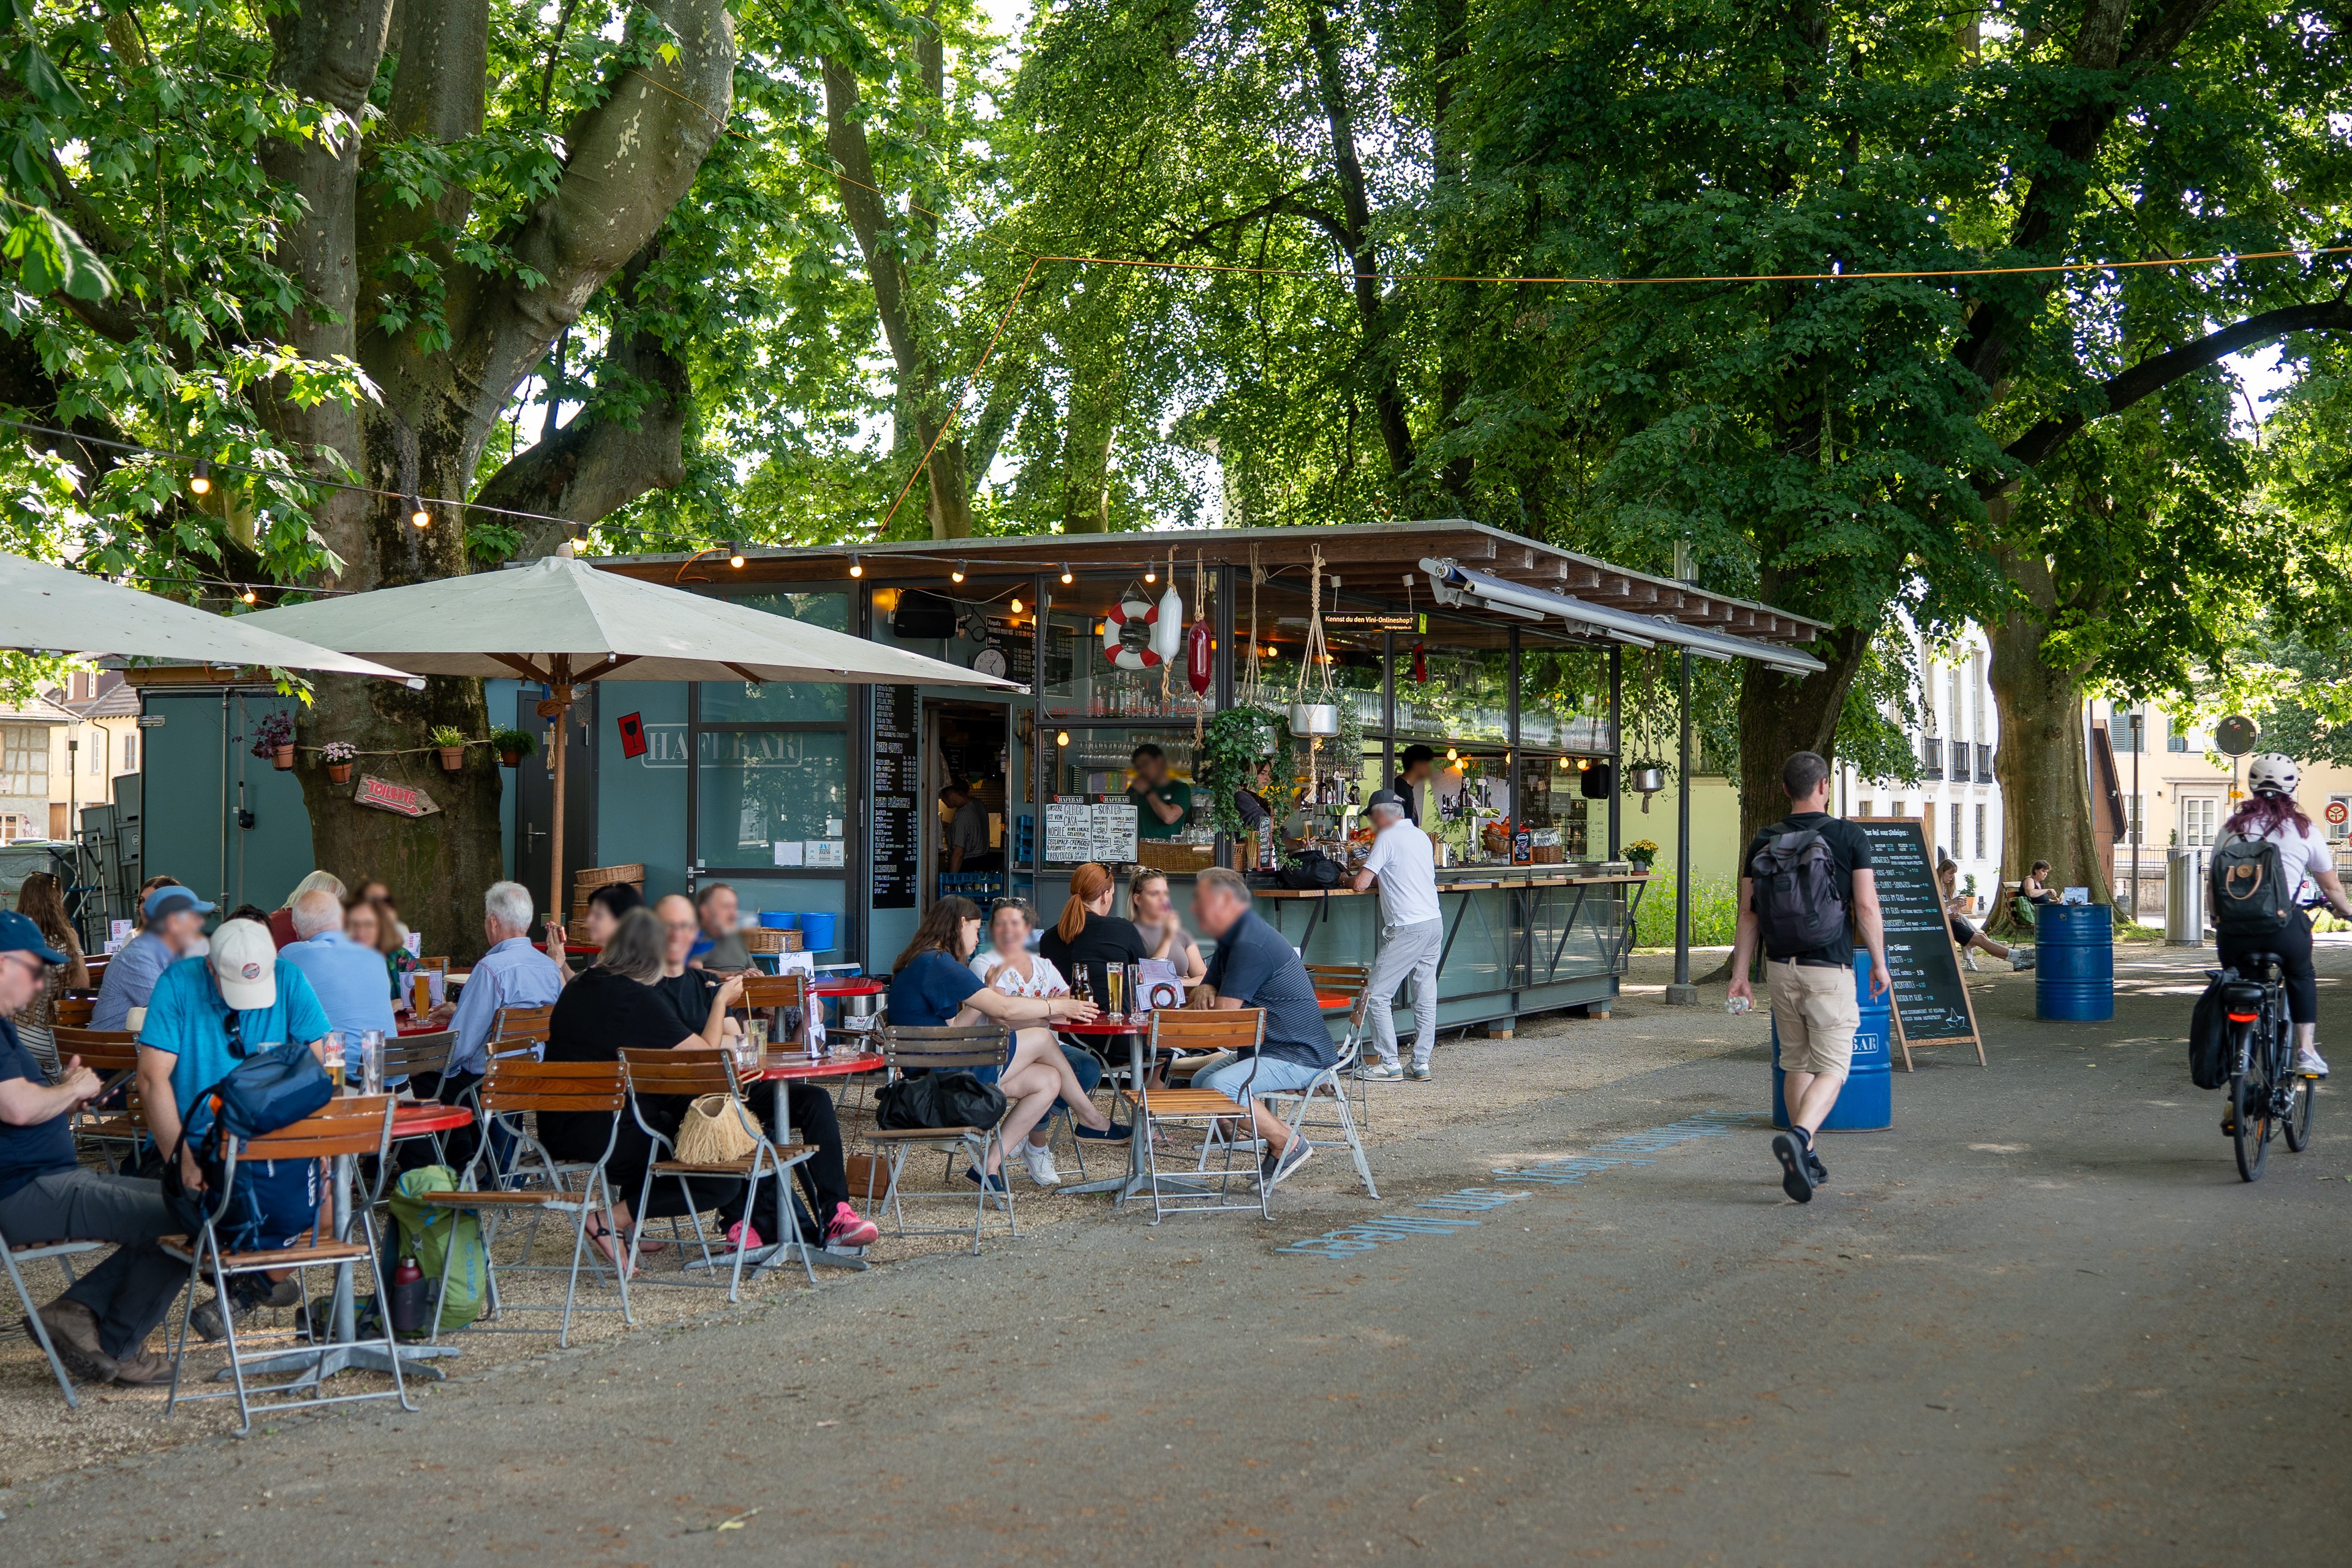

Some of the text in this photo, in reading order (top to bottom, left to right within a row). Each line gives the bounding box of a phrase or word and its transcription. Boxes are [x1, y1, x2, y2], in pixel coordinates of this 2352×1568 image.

[1365, 616, 1414, 625] Vini-Onlineshop?
[1162, 705, 1208, 714] bringe!
[366, 779, 418, 805] TOILETTE
[1098, 804, 1122, 815] SORTEN
[1063, 816, 1078, 827] CASA
